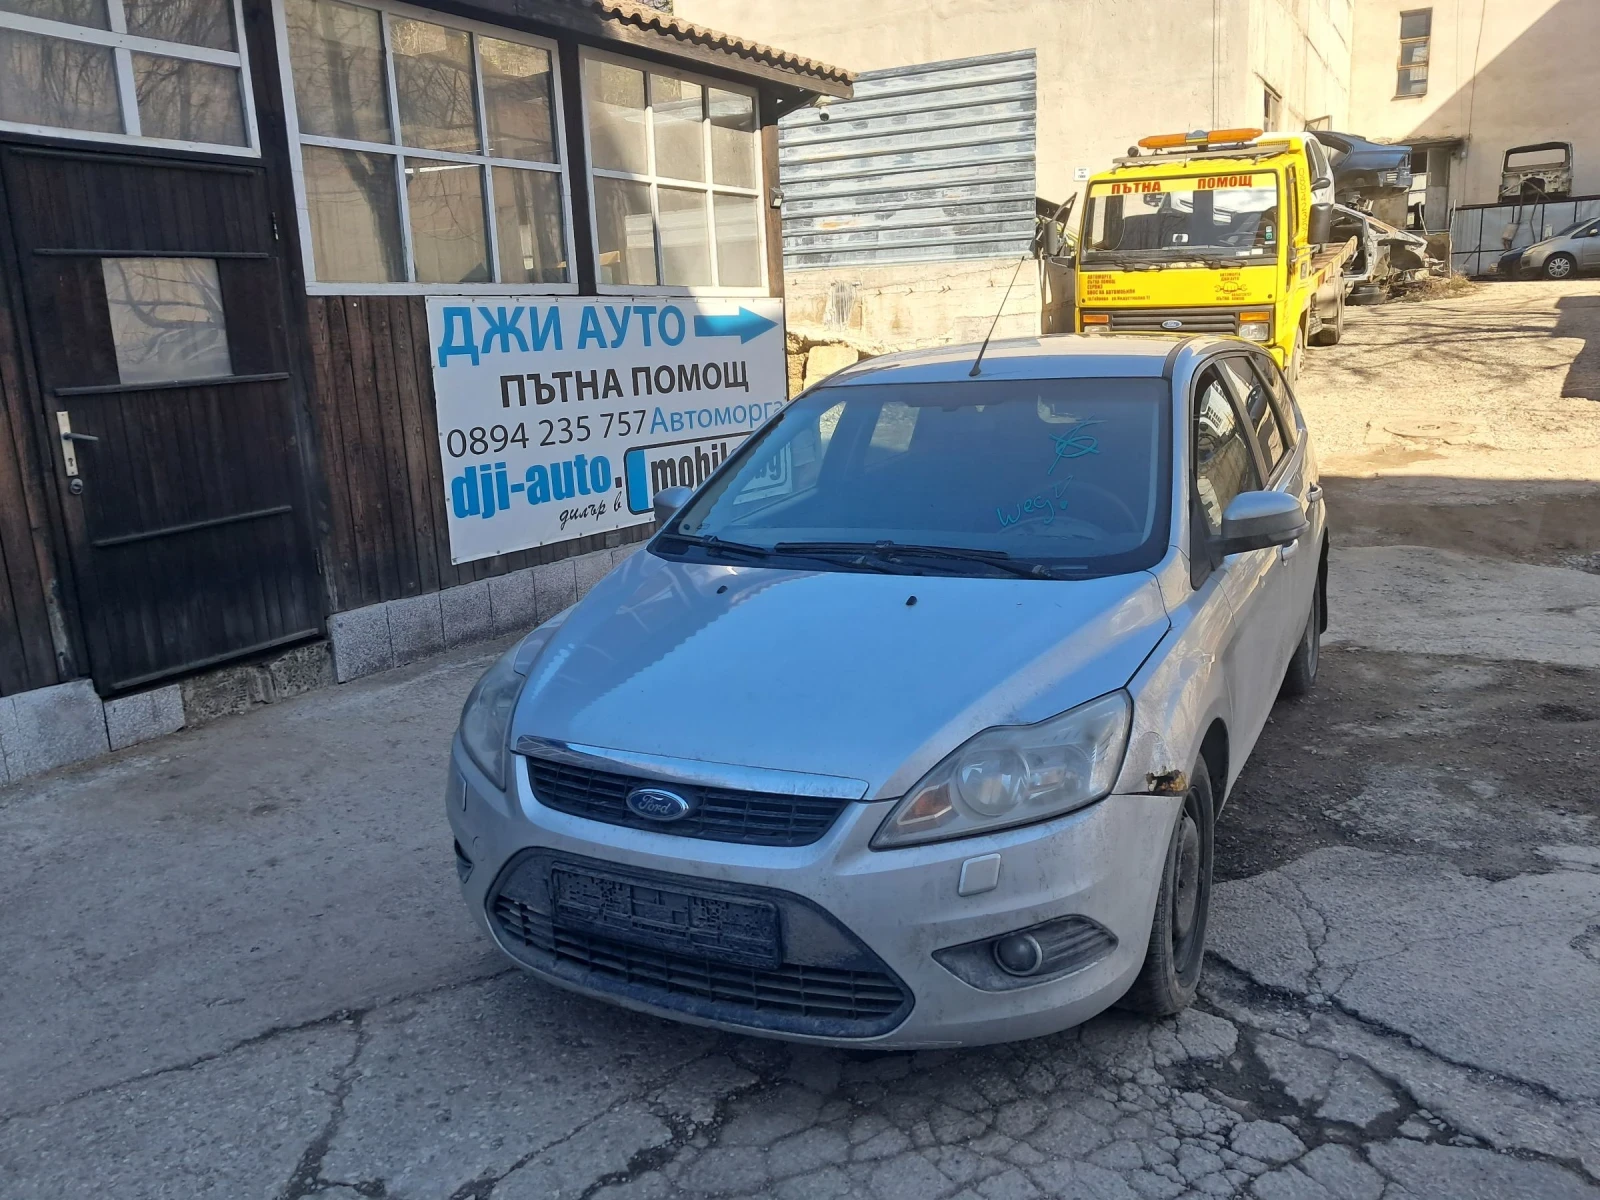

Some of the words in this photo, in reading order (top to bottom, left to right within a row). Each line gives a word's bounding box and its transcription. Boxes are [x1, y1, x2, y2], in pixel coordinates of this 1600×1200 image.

[1111, 181, 1161, 194] ПЪТНА
[1197, 175, 1252, 189] ПОМОЩ
[438, 306, 564, 367] ДЖИ
[577, 304, 686, 350] АУТО
[500, 368, 624, 408] ПЪТНА
[631, 360, 750, 397] ПОМОЩ
[446, 422, 530, 458] 0894
[538, 415, 591, 447] 235
[599, 409, 647, 439] 757
[559, 499, 608, 531] дилър
[638, 794, 672, 815] Ford
